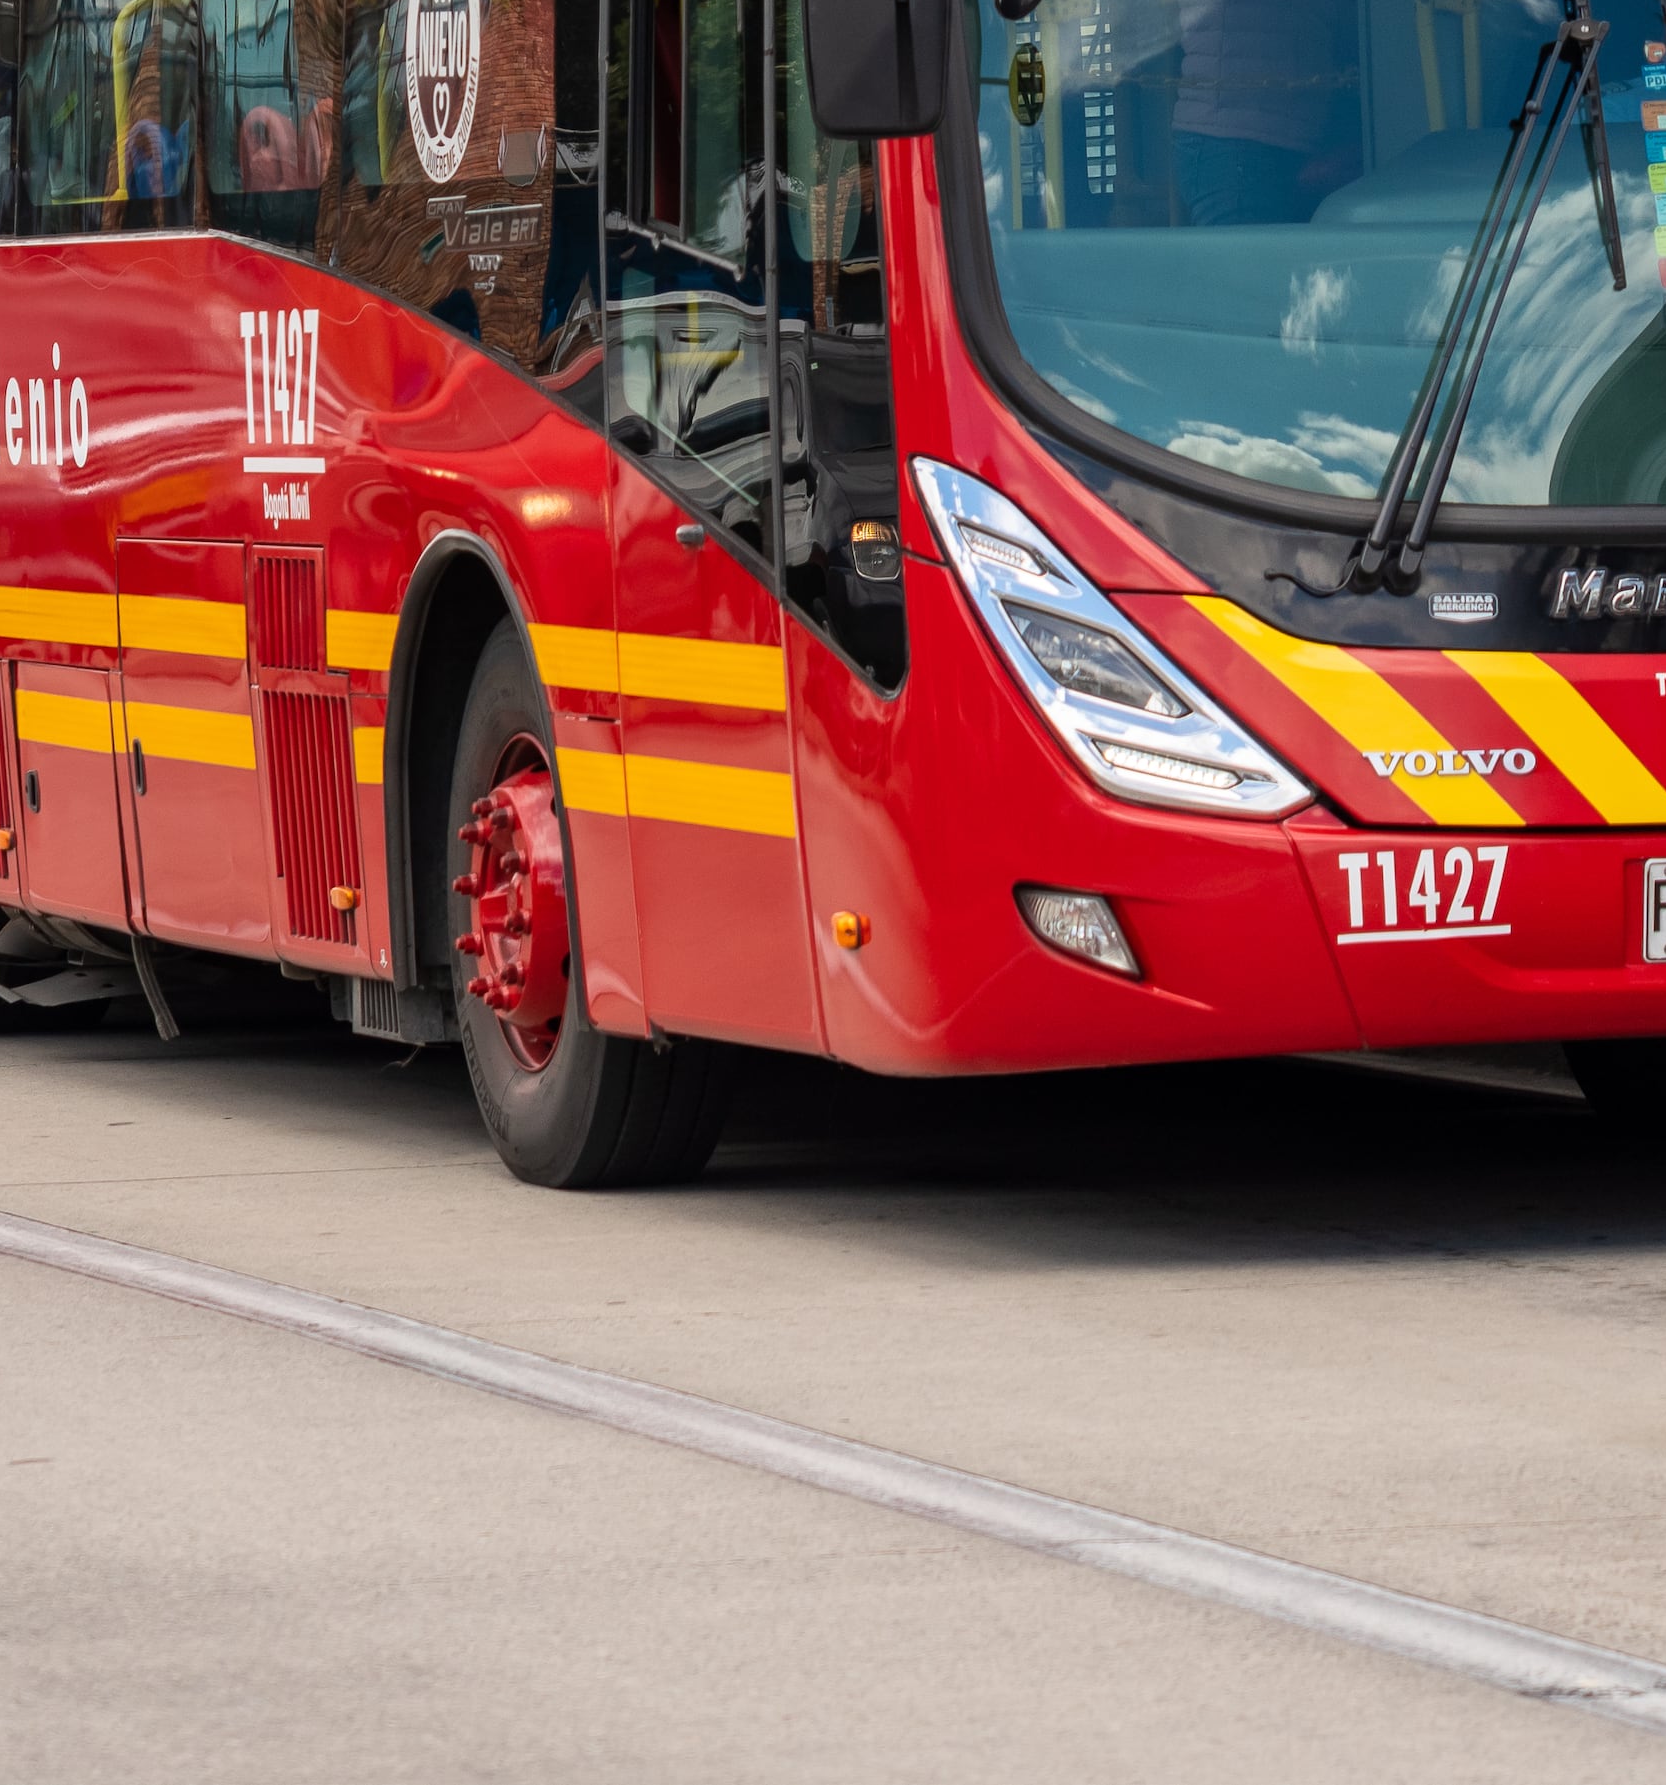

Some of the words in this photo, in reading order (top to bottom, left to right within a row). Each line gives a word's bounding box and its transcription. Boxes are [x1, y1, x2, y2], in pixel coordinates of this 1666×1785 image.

[419, 10, 468, 78] NUEVO
[1647, 76, 1666, 86] PDI
[427, 200, 463, 215] GRAN
[443, 214, 503, 247] Viale
[509, 217, 539, 242] BRT
[468, 254, 503, 271] VOLVO
[239, 308, 320, 445] T1427
[263, 481, 290, 530] Bogotá
[289, 480, 311, 520] Móvil
[1433, 595, 1493, 603] SALIDAS
[1433, 603, 1493, 611] EMERGENCIA
[1362, 748, 1537, 777] VOLVO
[1338, 845, 1509, 928] T1427
